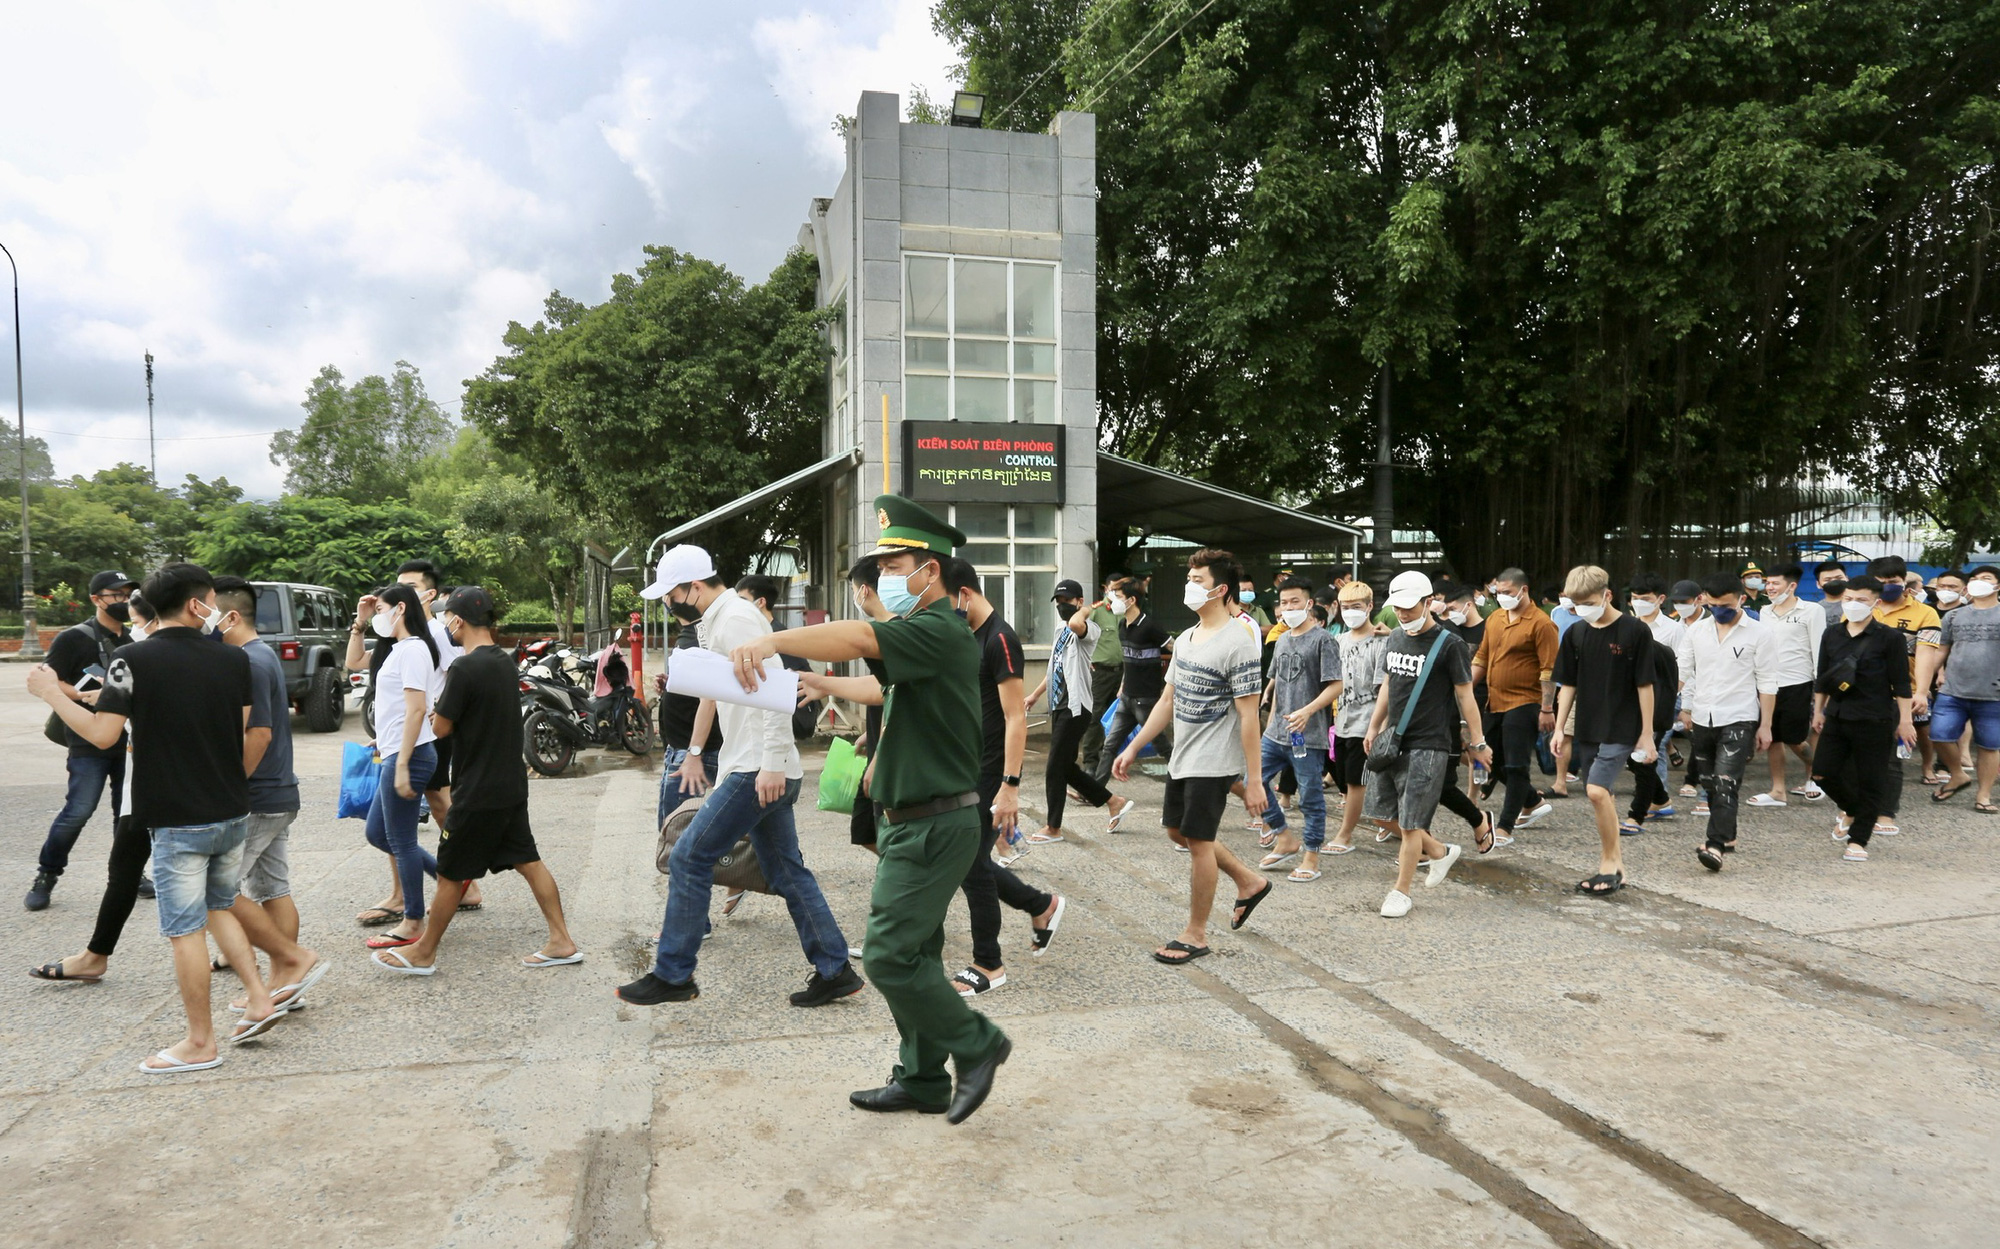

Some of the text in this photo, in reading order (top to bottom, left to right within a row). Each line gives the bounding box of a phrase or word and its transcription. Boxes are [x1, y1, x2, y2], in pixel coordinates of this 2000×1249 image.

[950, 437, 980, 450] SOÁT
[982, 438, 1011, 451] BIÊN
[1013, 439, 1054, 452] PHÒNG
[1005, 454, 1058, 467] CONTROL
